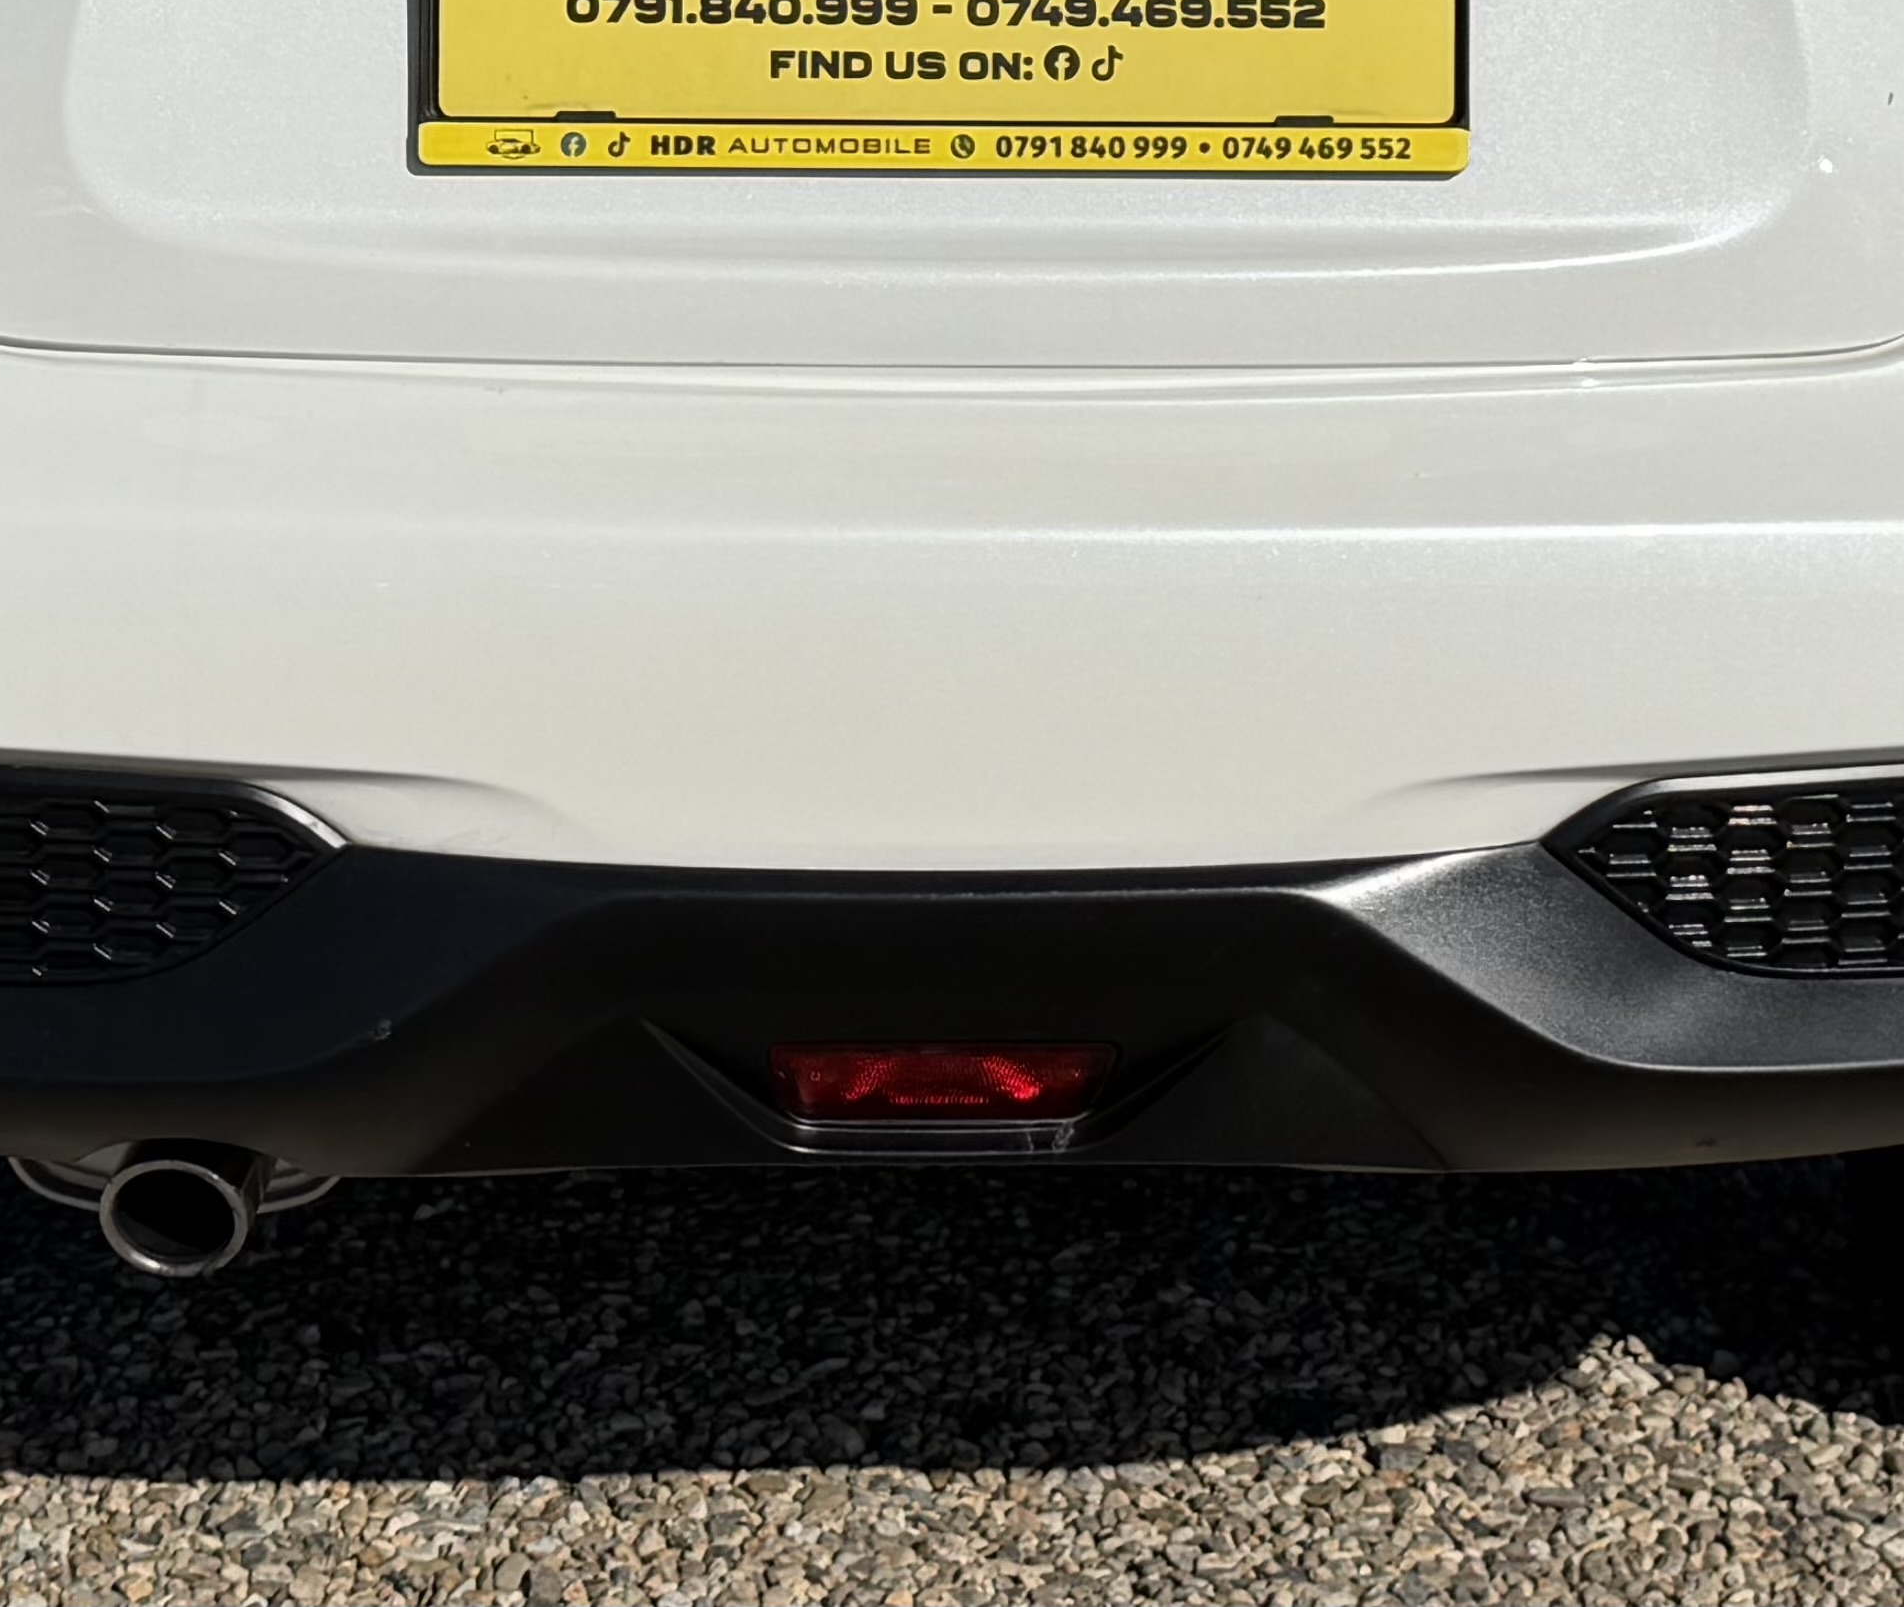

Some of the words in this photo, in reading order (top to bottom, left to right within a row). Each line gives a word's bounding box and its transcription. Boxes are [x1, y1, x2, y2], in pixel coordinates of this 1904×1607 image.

[770, 50, 873, 80] FIND
[885, 51, 947, 81] US
[959, 51, 1034, 81] ON:
[650, 134, 716, 156] HDR
[727, 137, 932, 155] AUTOMOBILE
[995, 135, 1063, 159] 0791
[1070, 135, 1127, 160] 840
[1133, 136, 1189, 160] 999
[1222, 136, 1293, 161] 0749
[1298, 136, 1354, 161] 469
[1360, 137, 1412, 161] 552
